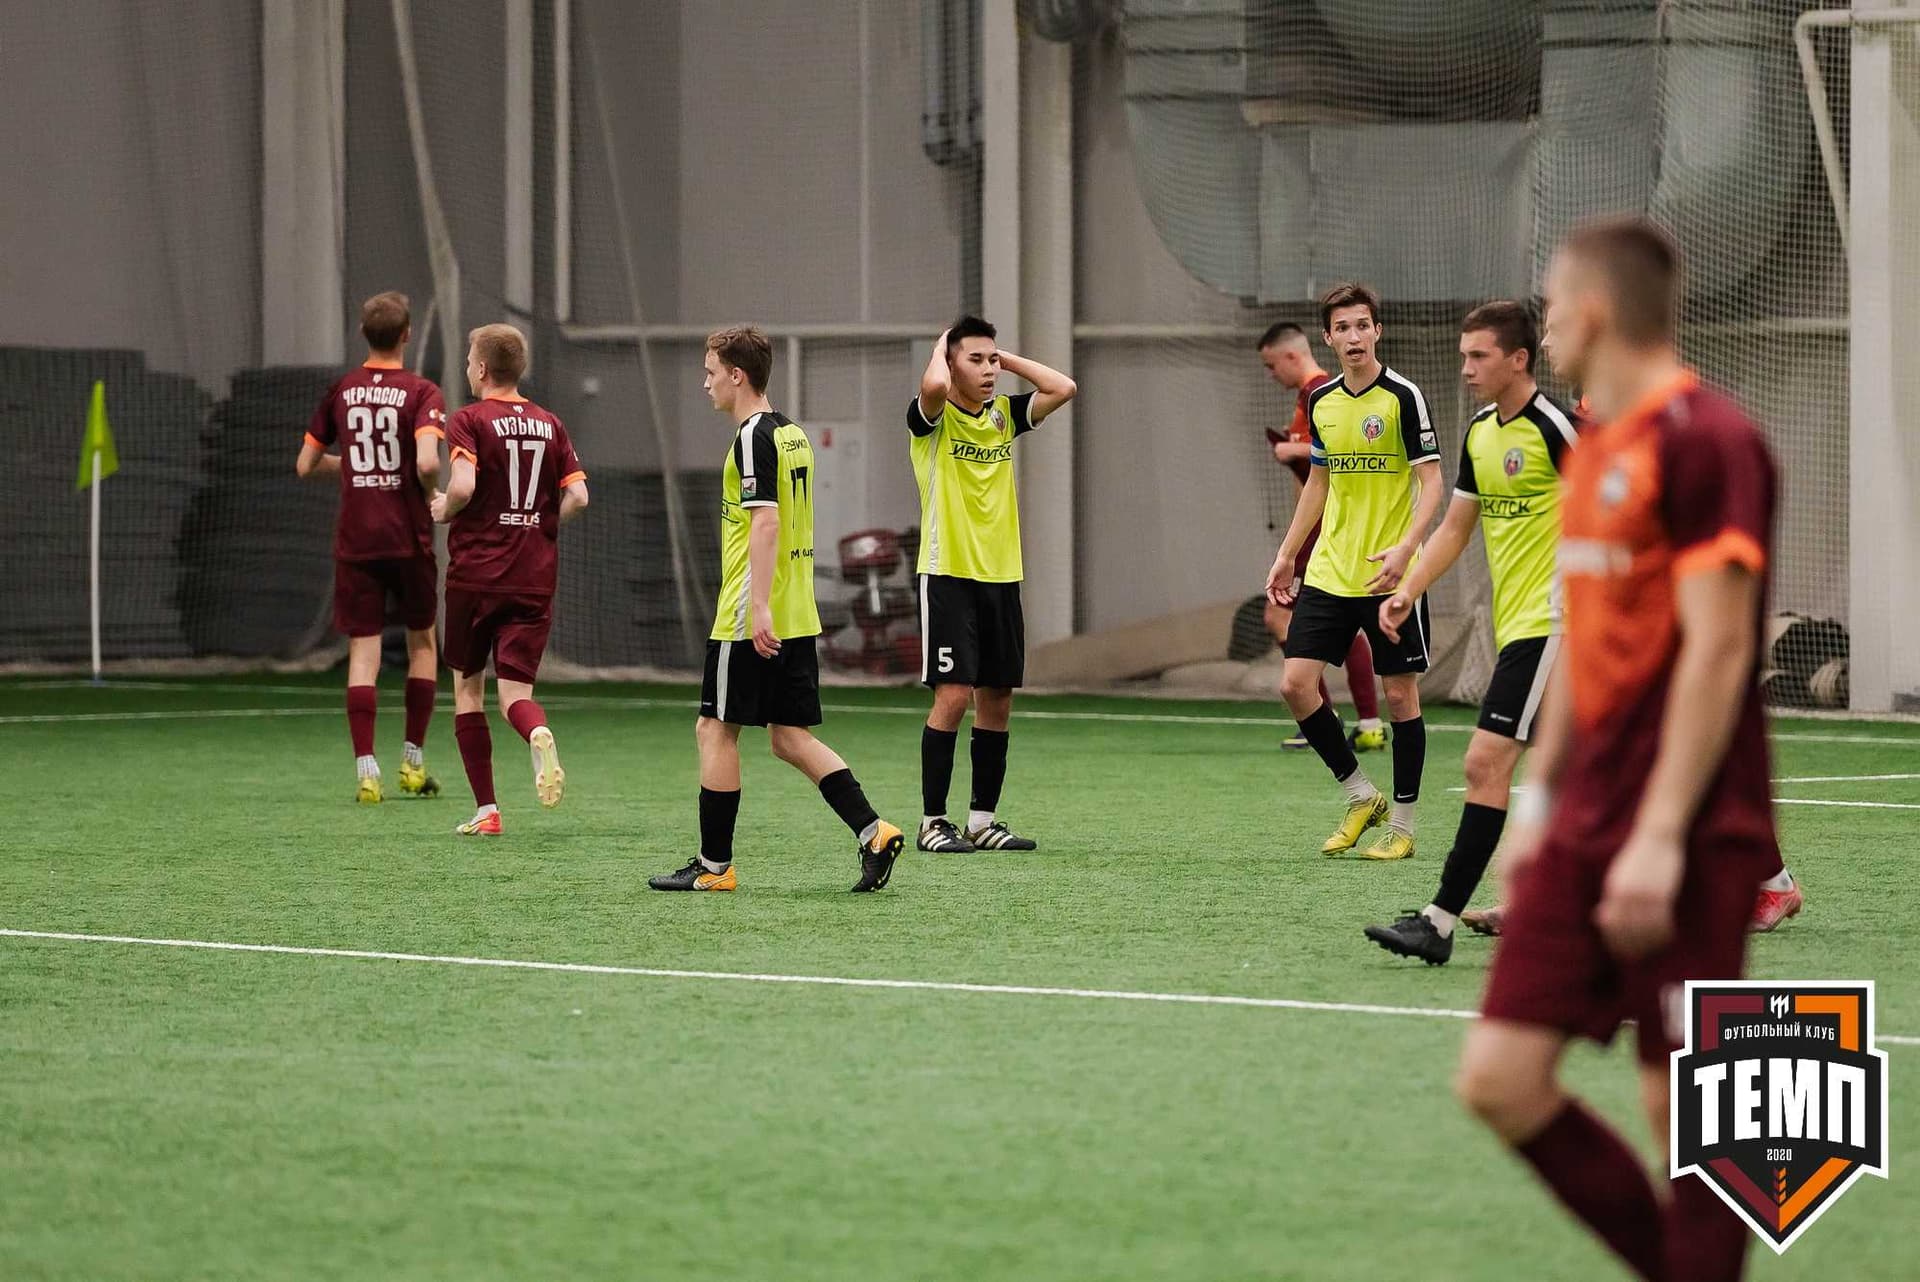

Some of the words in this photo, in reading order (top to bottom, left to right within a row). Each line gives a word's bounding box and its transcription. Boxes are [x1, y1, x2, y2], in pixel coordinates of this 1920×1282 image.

[343, 387, 407, 407] ЧЕРКАСОВ
[492, 417, 553, 440] КУЗЬКИН
[347, 406, 401, 473] 33
[952, 444, 1011, 460] ИРКУТСК
[352, 475, 401, 488] SEUS
[505, 439, 546, 510] 17
[499, 511, 540, 526] SEUS
[938, 647, 953, 673] 5
